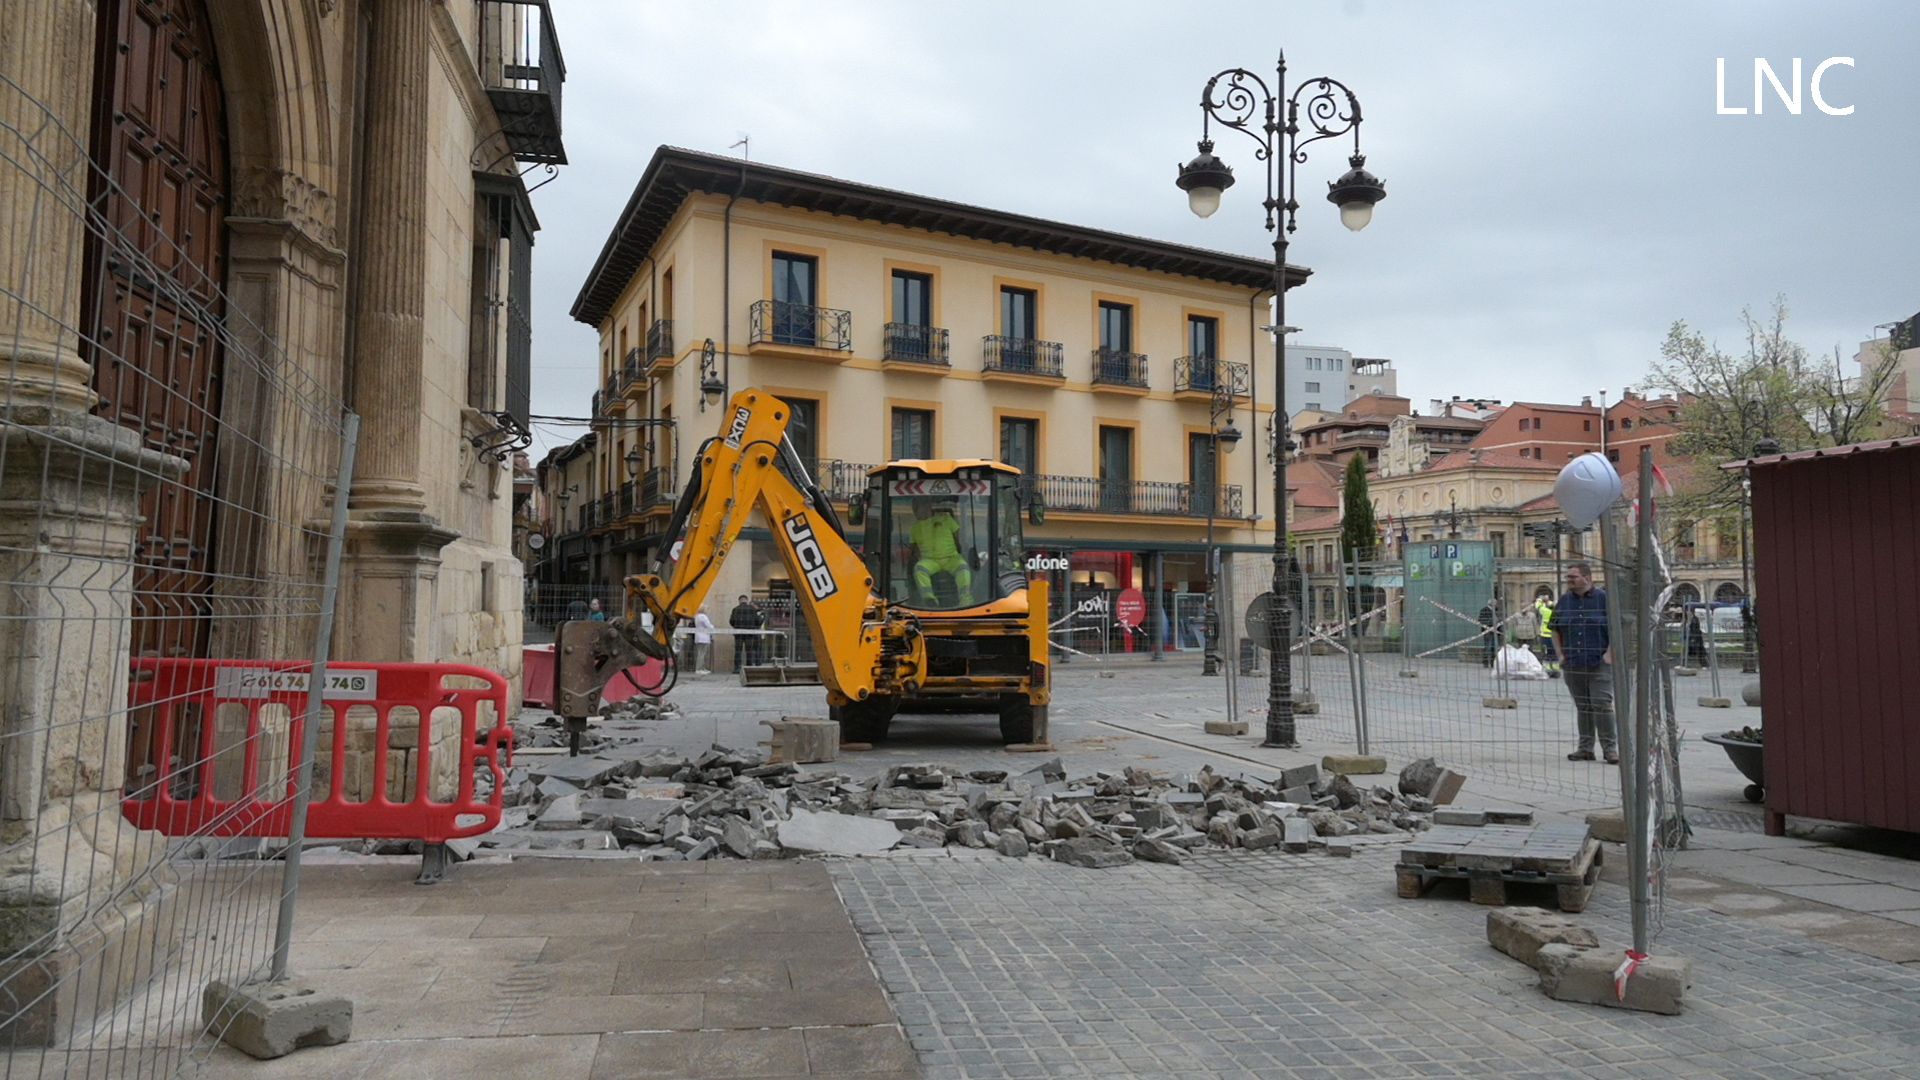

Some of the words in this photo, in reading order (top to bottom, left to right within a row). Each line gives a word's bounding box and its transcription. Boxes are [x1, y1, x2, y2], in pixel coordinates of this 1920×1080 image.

[785, 519, 835, 599] JCB
[1027, 554, 1069, 570] afone
[1452, 561, 1488, 577] Park
[287, 675, 305, 689] 74
[331, 677, 349, 690] 74
